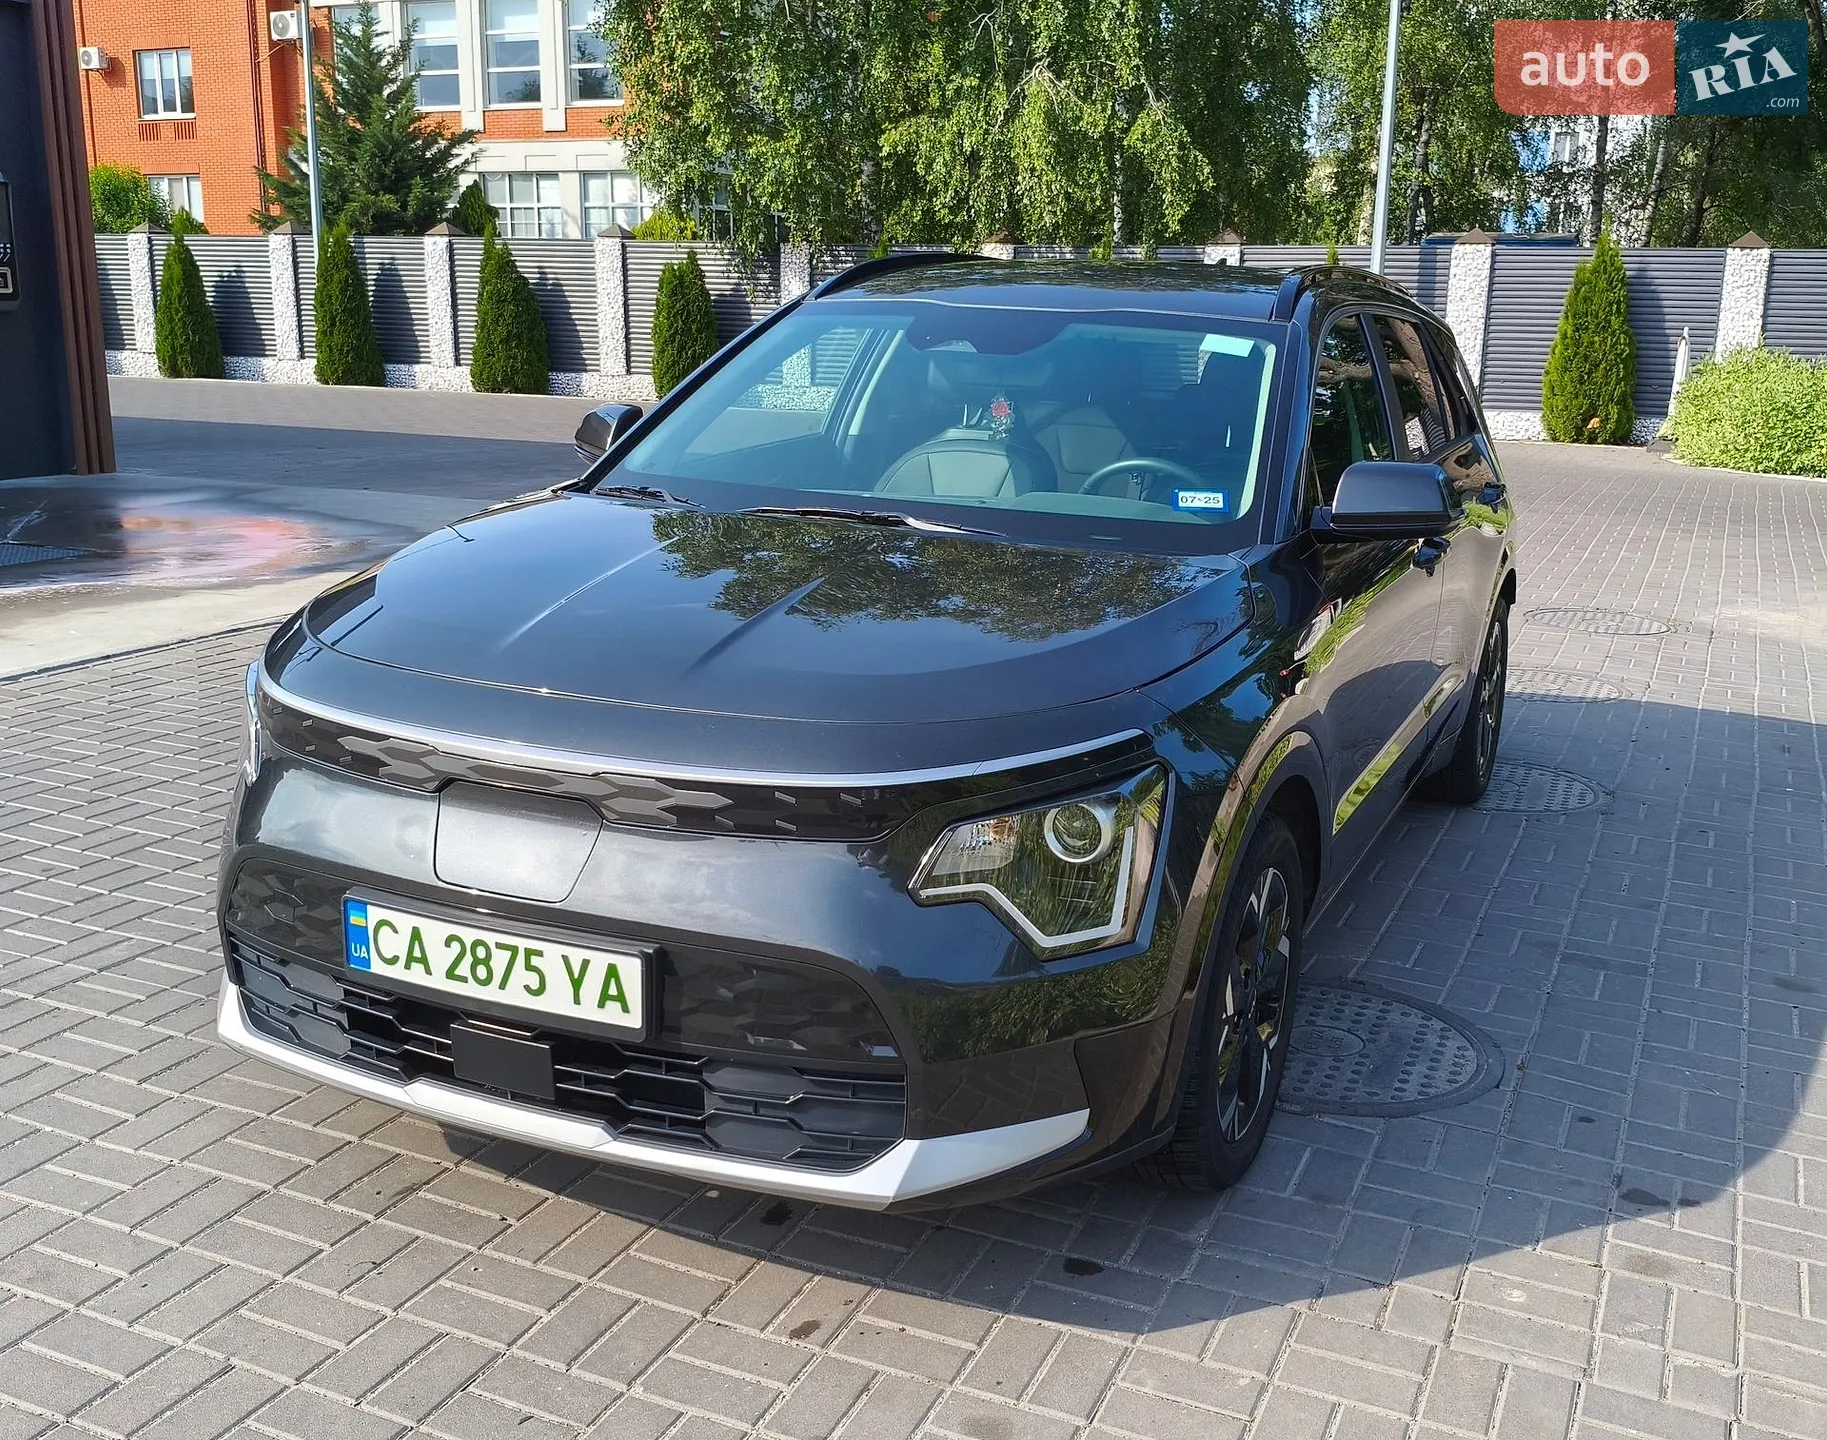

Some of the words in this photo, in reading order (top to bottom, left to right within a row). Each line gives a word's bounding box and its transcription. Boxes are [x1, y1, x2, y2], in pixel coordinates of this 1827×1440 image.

[351, 945, 369, 960] UA
[373, 919, 433, 976] CA
[444, 933, 547, 997] 2875
[561, 954, 631, 1014] YA
